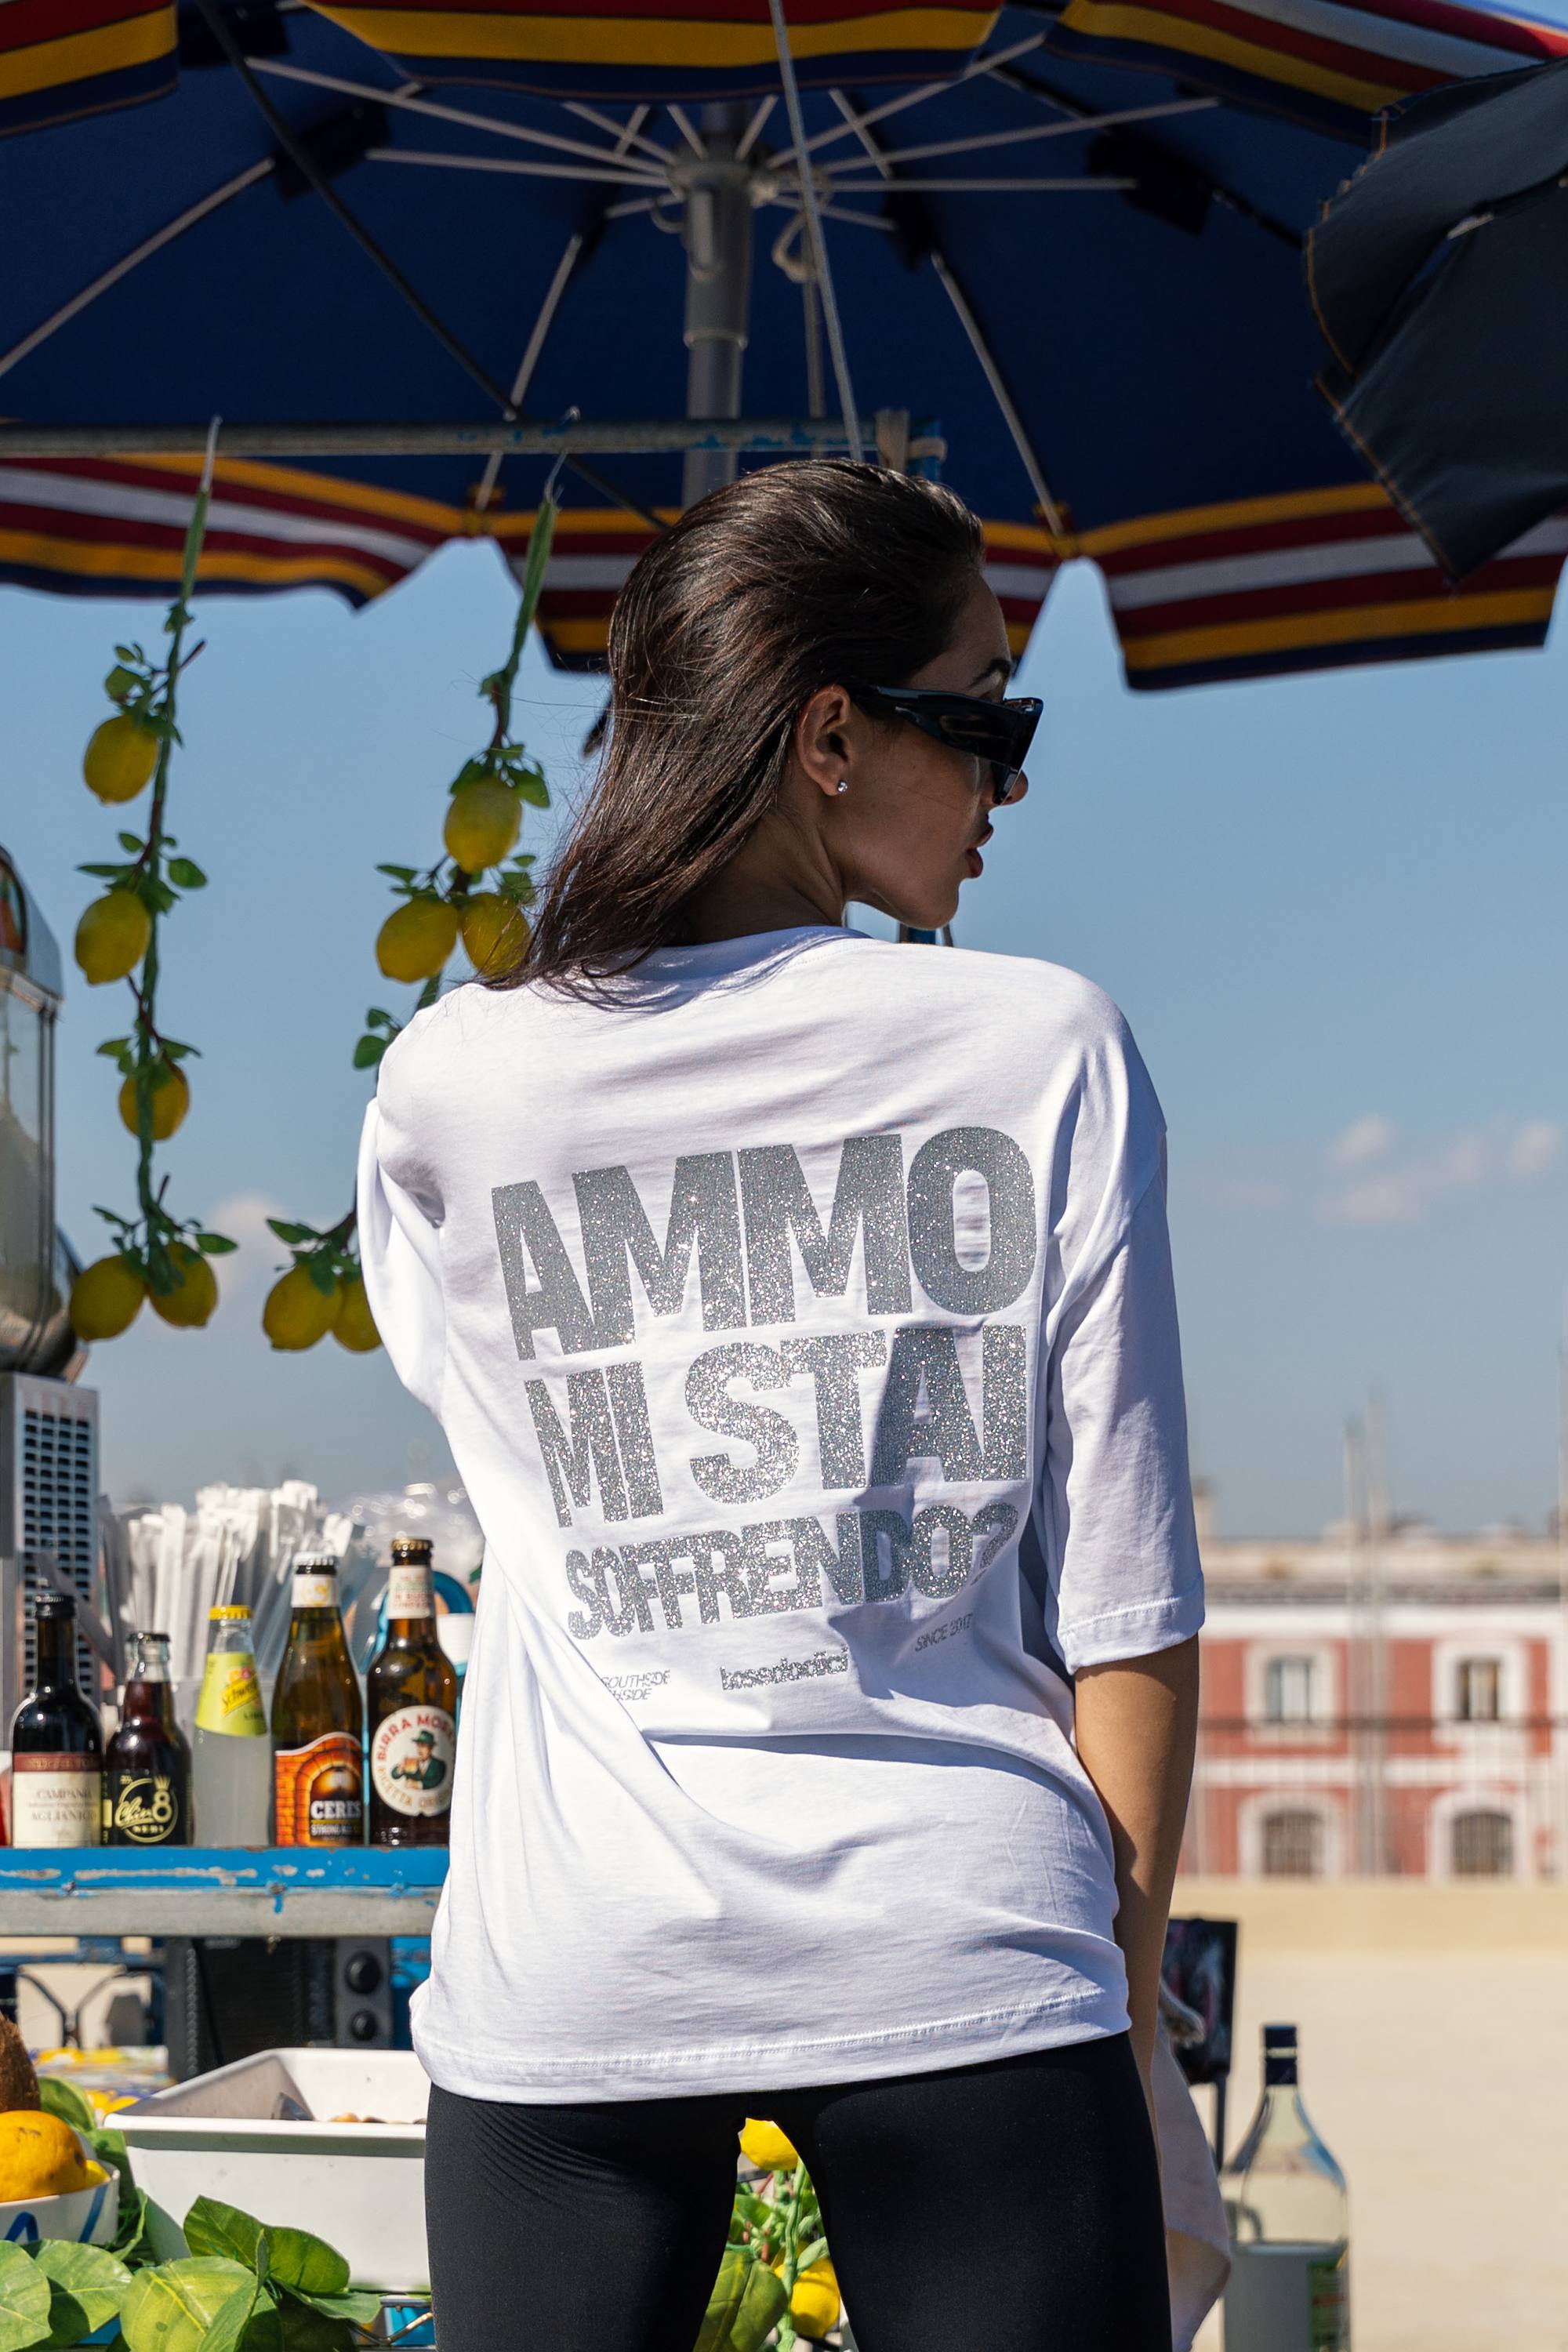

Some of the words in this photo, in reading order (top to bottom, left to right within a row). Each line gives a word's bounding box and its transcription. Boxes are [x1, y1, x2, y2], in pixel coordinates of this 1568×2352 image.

[491, 1126, 1037, 1361] AMMO
[524, 1361, 665, 1529] MI
[684, 1325, 1028, 1504] STAI
[565, 1503, 1019, 1641] SOFFRENDO?
[915, 1624, 948, 1652] SINCE
[377, 1717, 412, 1762] BIRRA
[310, 1800, 361, 1820] CERES
